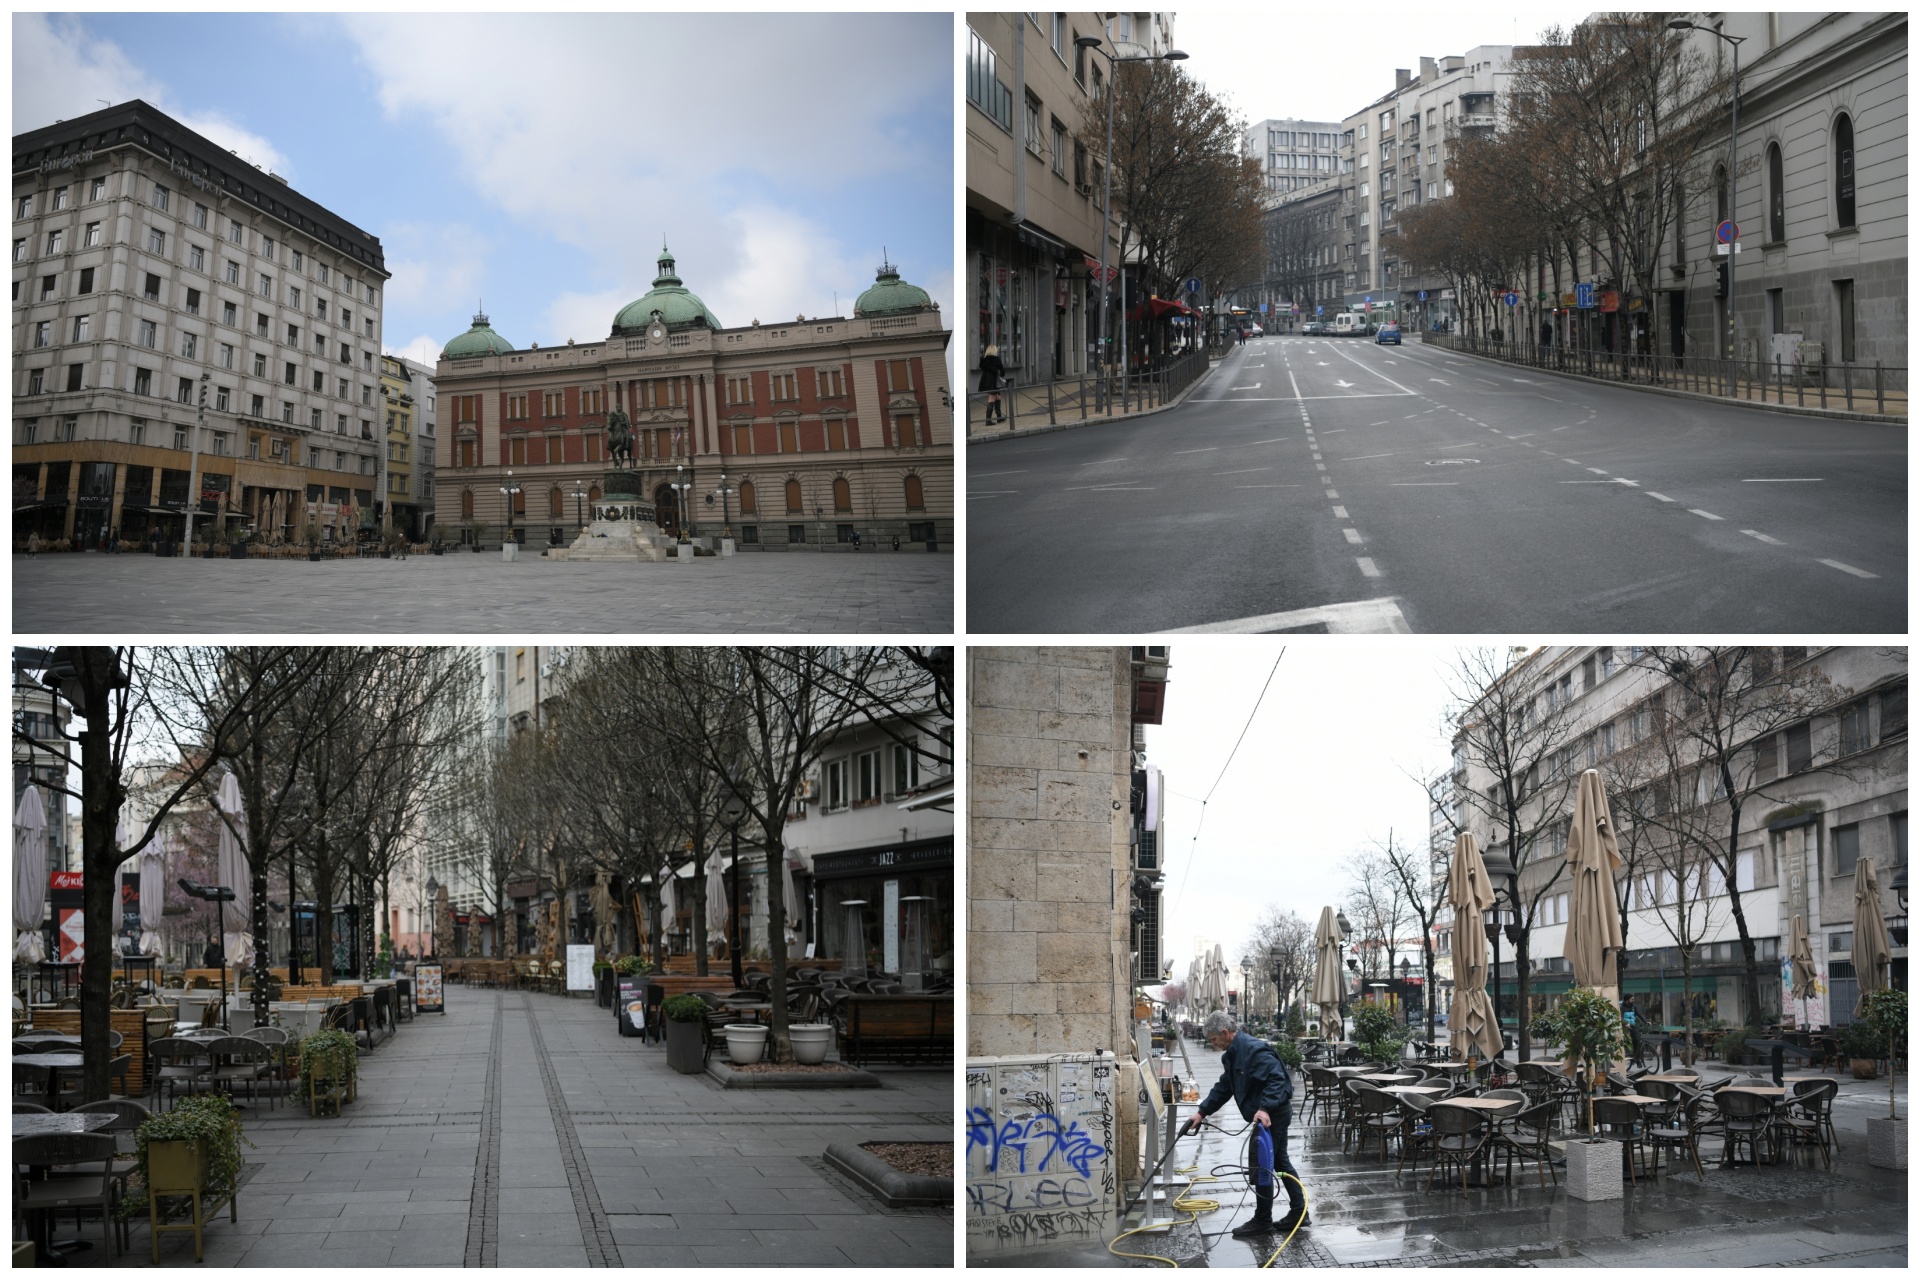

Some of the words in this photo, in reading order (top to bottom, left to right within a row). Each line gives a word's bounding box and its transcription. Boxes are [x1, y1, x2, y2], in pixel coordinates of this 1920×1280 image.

[201, 491, 229, 500] PIZZA
[879, 852, 894, 866] JAZZ
[54, 874, 70, 887] Moj
